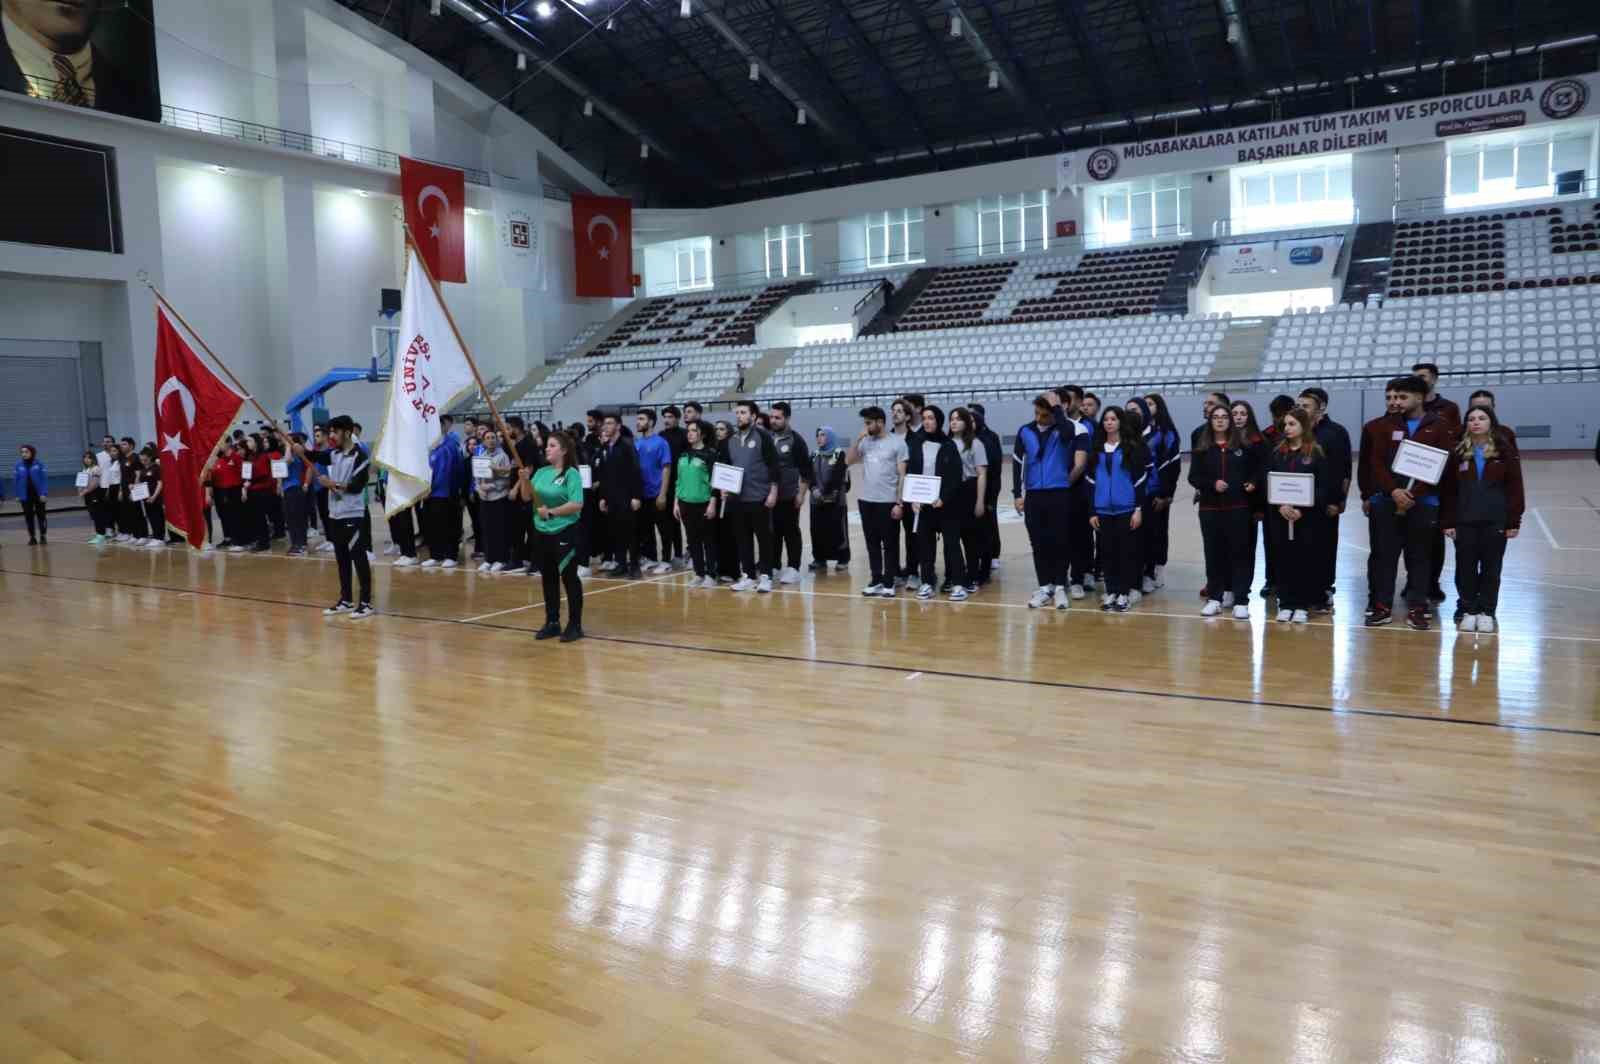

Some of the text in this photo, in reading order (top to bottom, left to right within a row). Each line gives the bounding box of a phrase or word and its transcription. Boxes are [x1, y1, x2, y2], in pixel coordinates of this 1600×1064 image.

[1123, 132, 1235, 160] MÜSABAKALARA
[1238, 122, 1300, 144] KATILAN
[1305, 116, 1337, 132] TÜM
[1341, 108, 1391, 129] TAKIM
[1394, 105, 1415, 121] VE
[1420, 87, 1534, 118] SPORCULARA
[1237, 129, 1388, 164] BAŞARILAR DİLERİM
